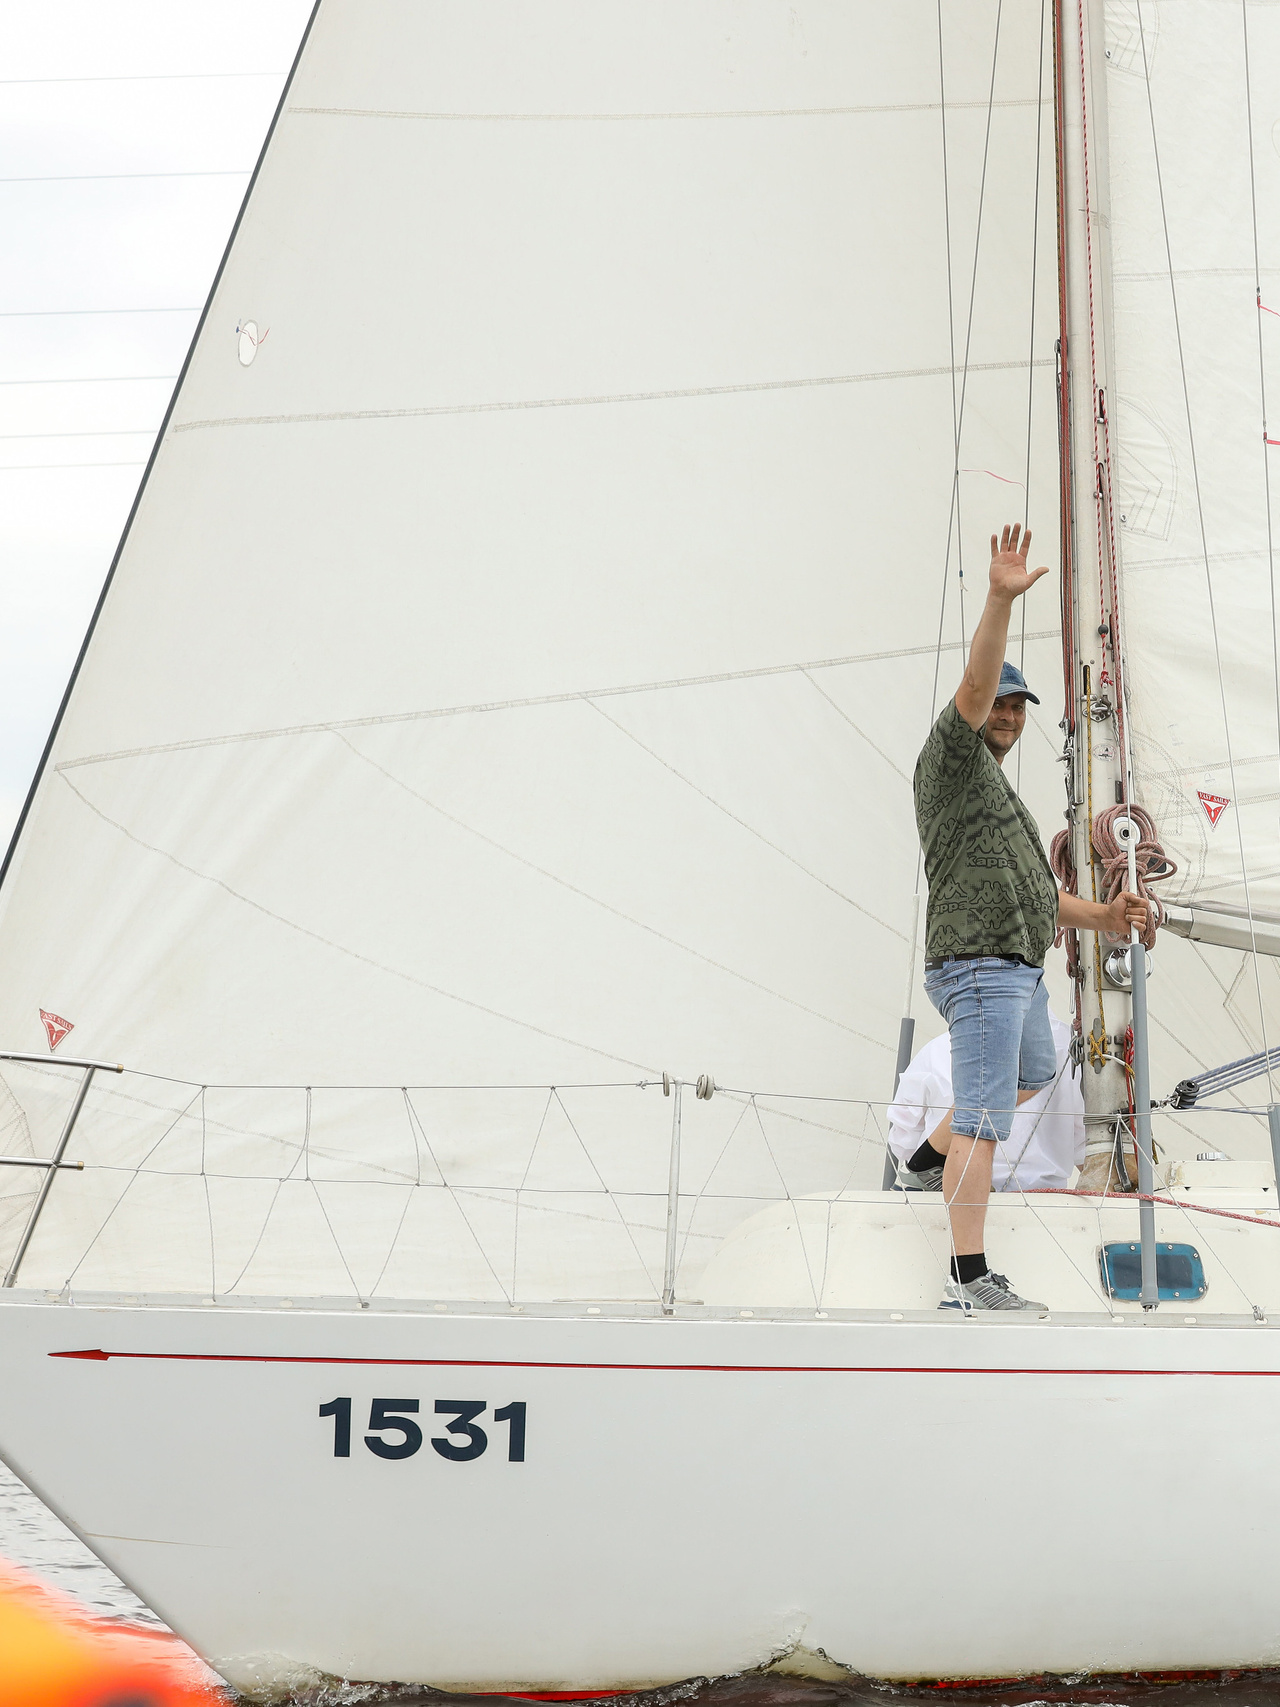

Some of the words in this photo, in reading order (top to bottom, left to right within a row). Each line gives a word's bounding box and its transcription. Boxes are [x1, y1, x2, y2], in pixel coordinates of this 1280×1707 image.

[967, 855, 1017, 871] Kappa
[928, 901, 967, 915] Kappa
[319, 1396, 527, 1463] 1531
